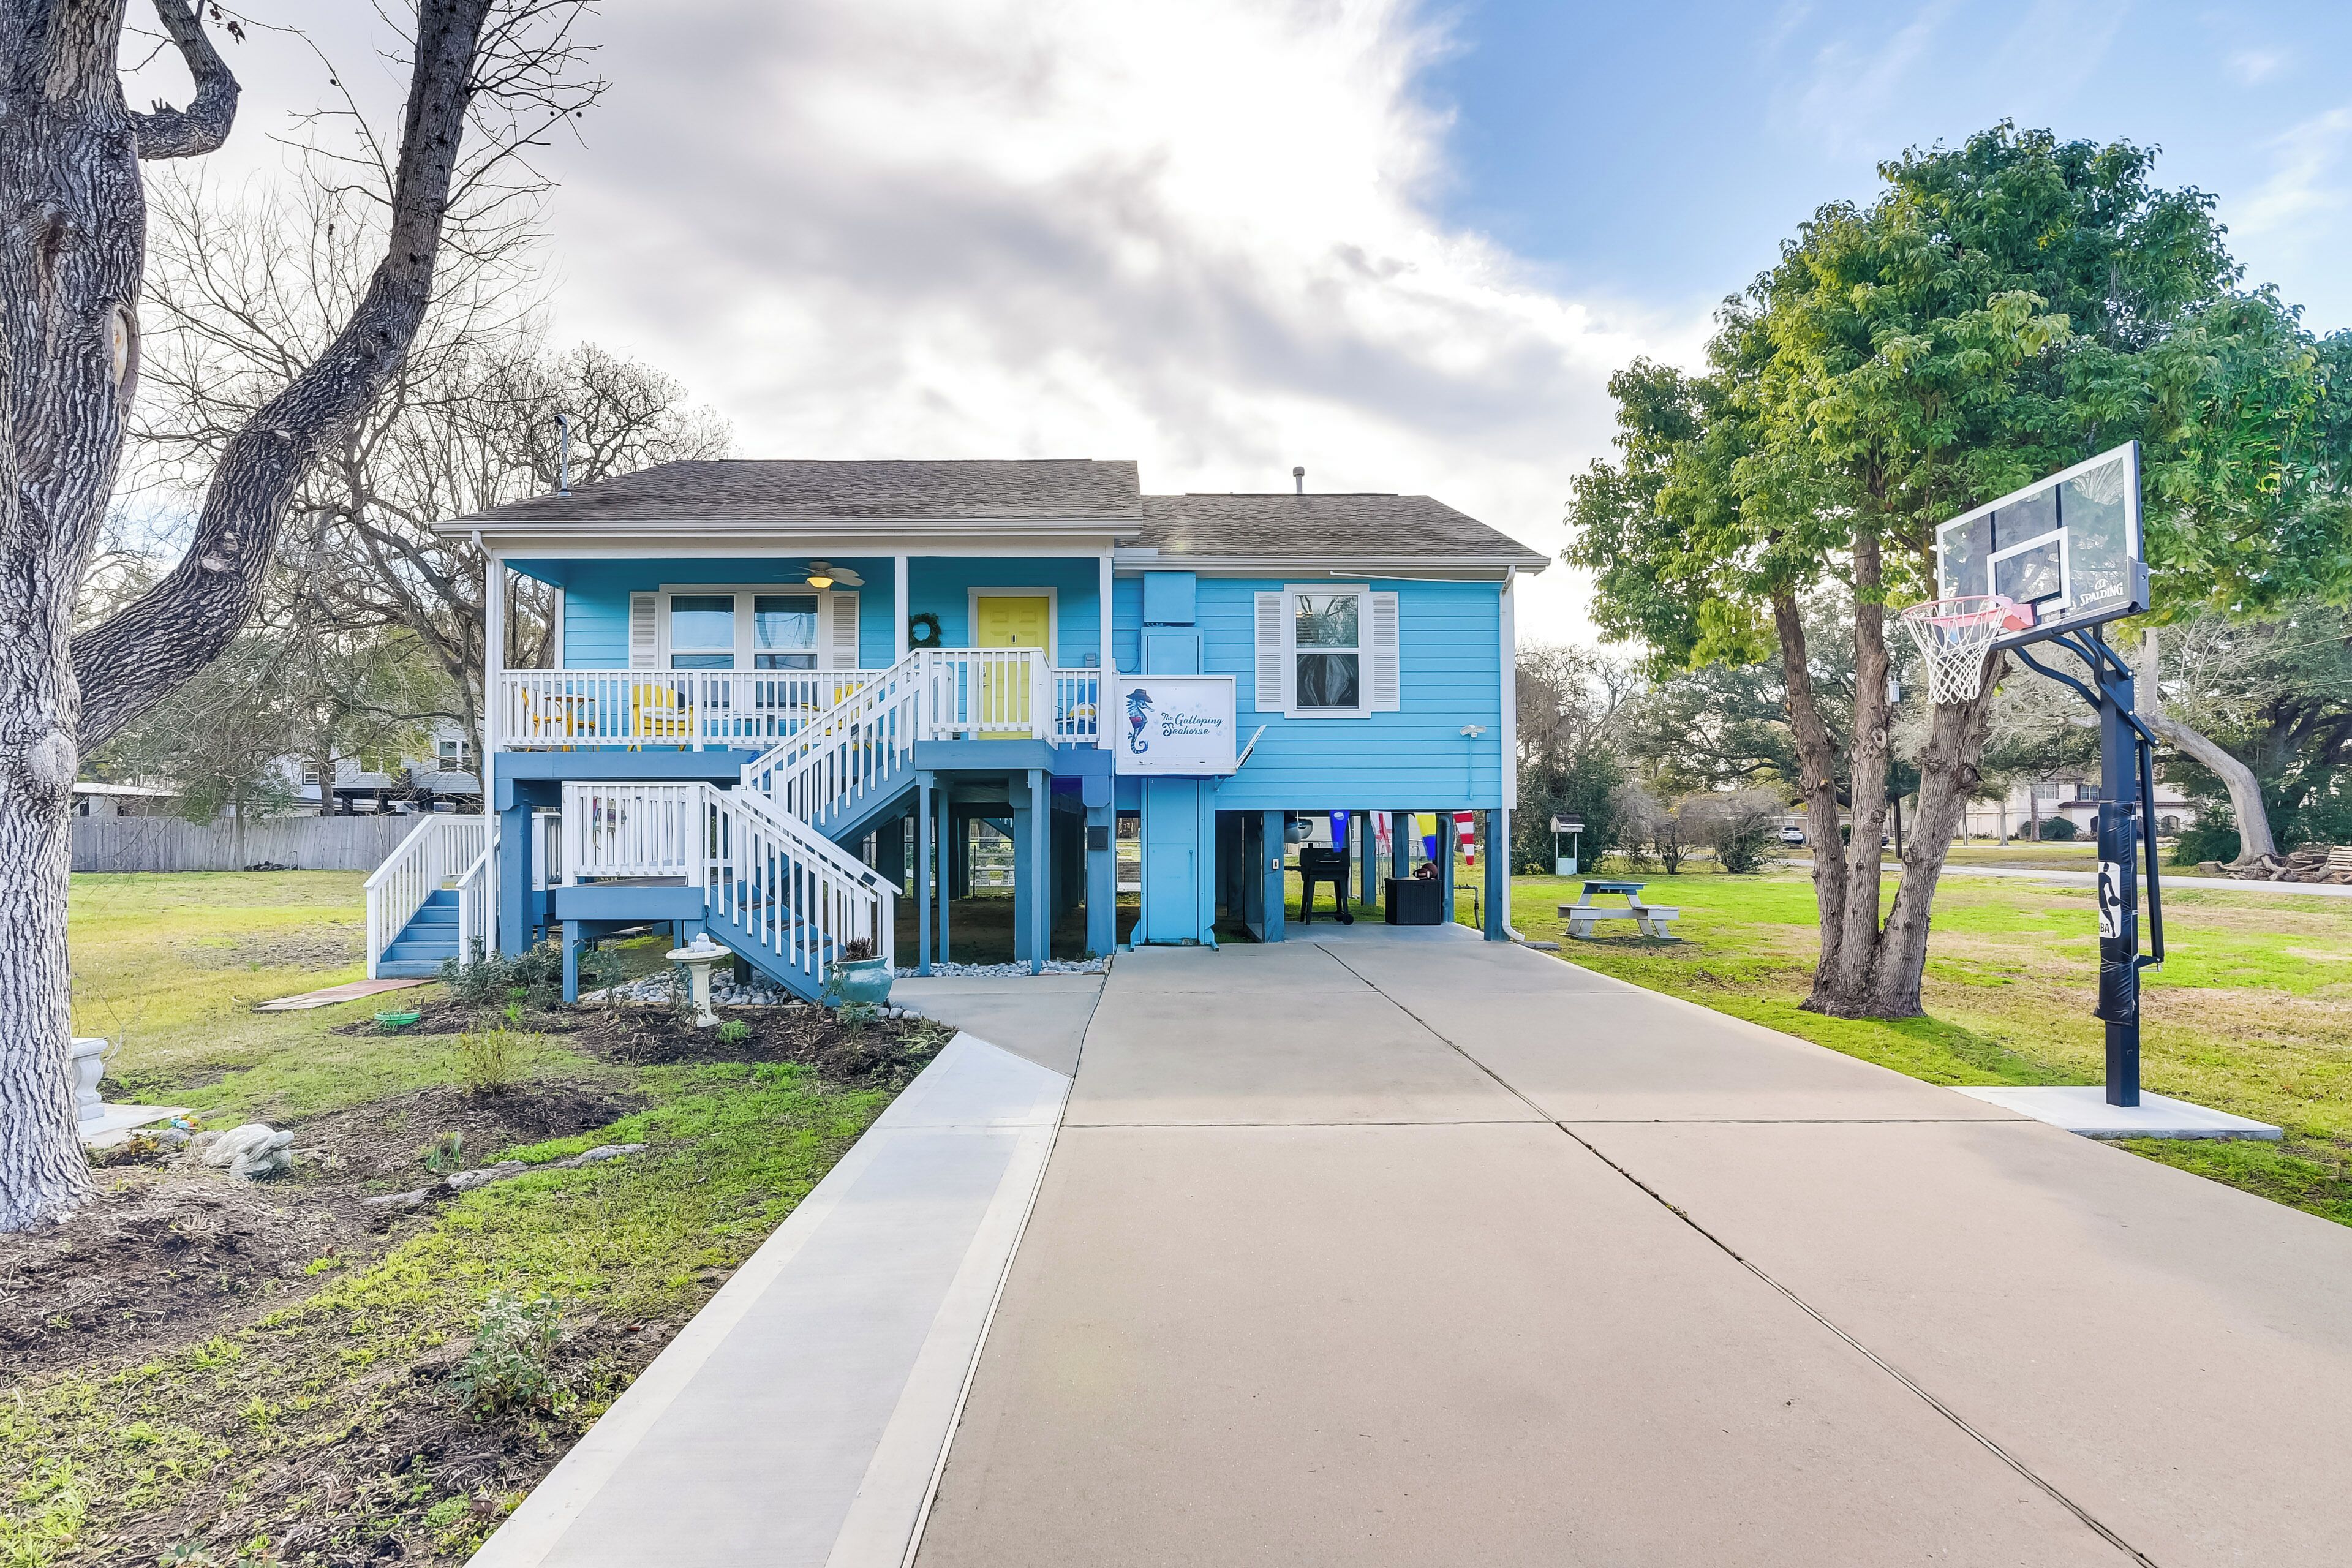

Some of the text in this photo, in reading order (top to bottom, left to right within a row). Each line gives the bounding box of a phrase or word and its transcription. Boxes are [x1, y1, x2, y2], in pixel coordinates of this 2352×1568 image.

[2080, 582, 2124, 606] SPALDING
[1161, 712, 1224, 728] The Galloping
[1161, 722, 1210, 737] Seahorse
[2099, 923, 2110, 933] BA
